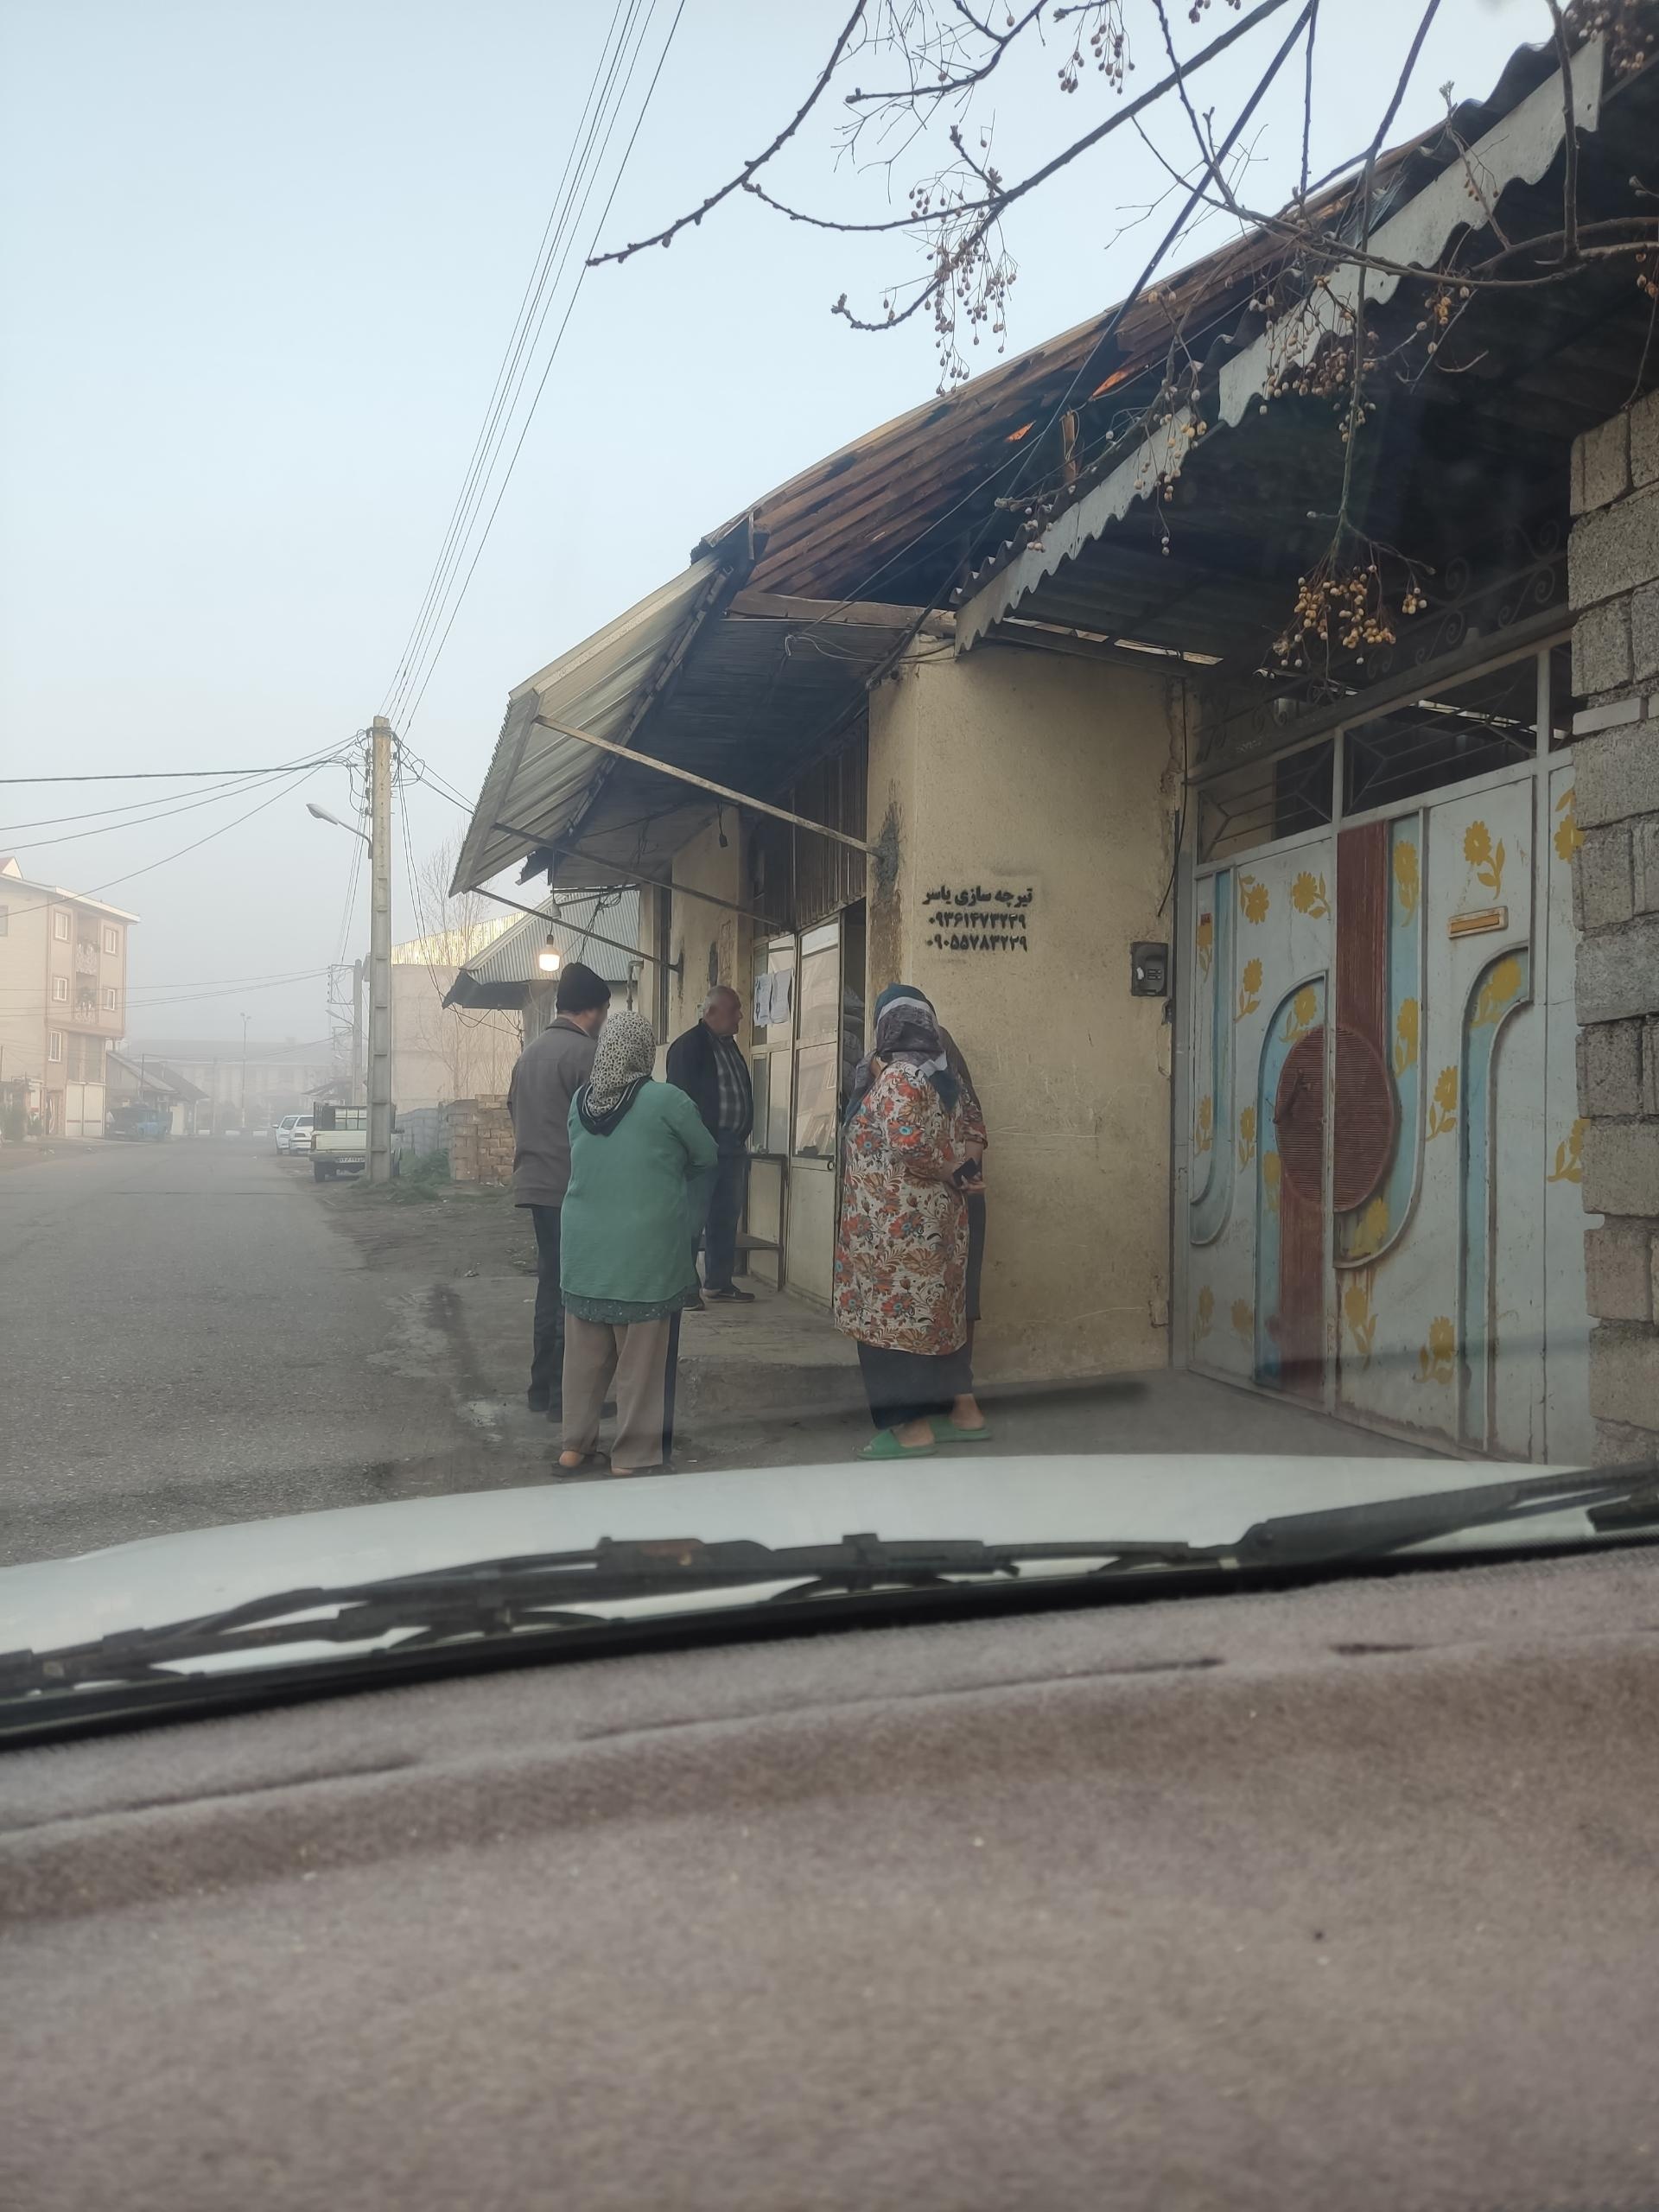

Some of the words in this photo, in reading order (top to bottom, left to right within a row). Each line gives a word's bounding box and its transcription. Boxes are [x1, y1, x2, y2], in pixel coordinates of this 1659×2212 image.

[922, 885, 951, 905] یاسر
[954, 886, 992, 906] سازی
[995, 887, 1033, 907] تیرچه
